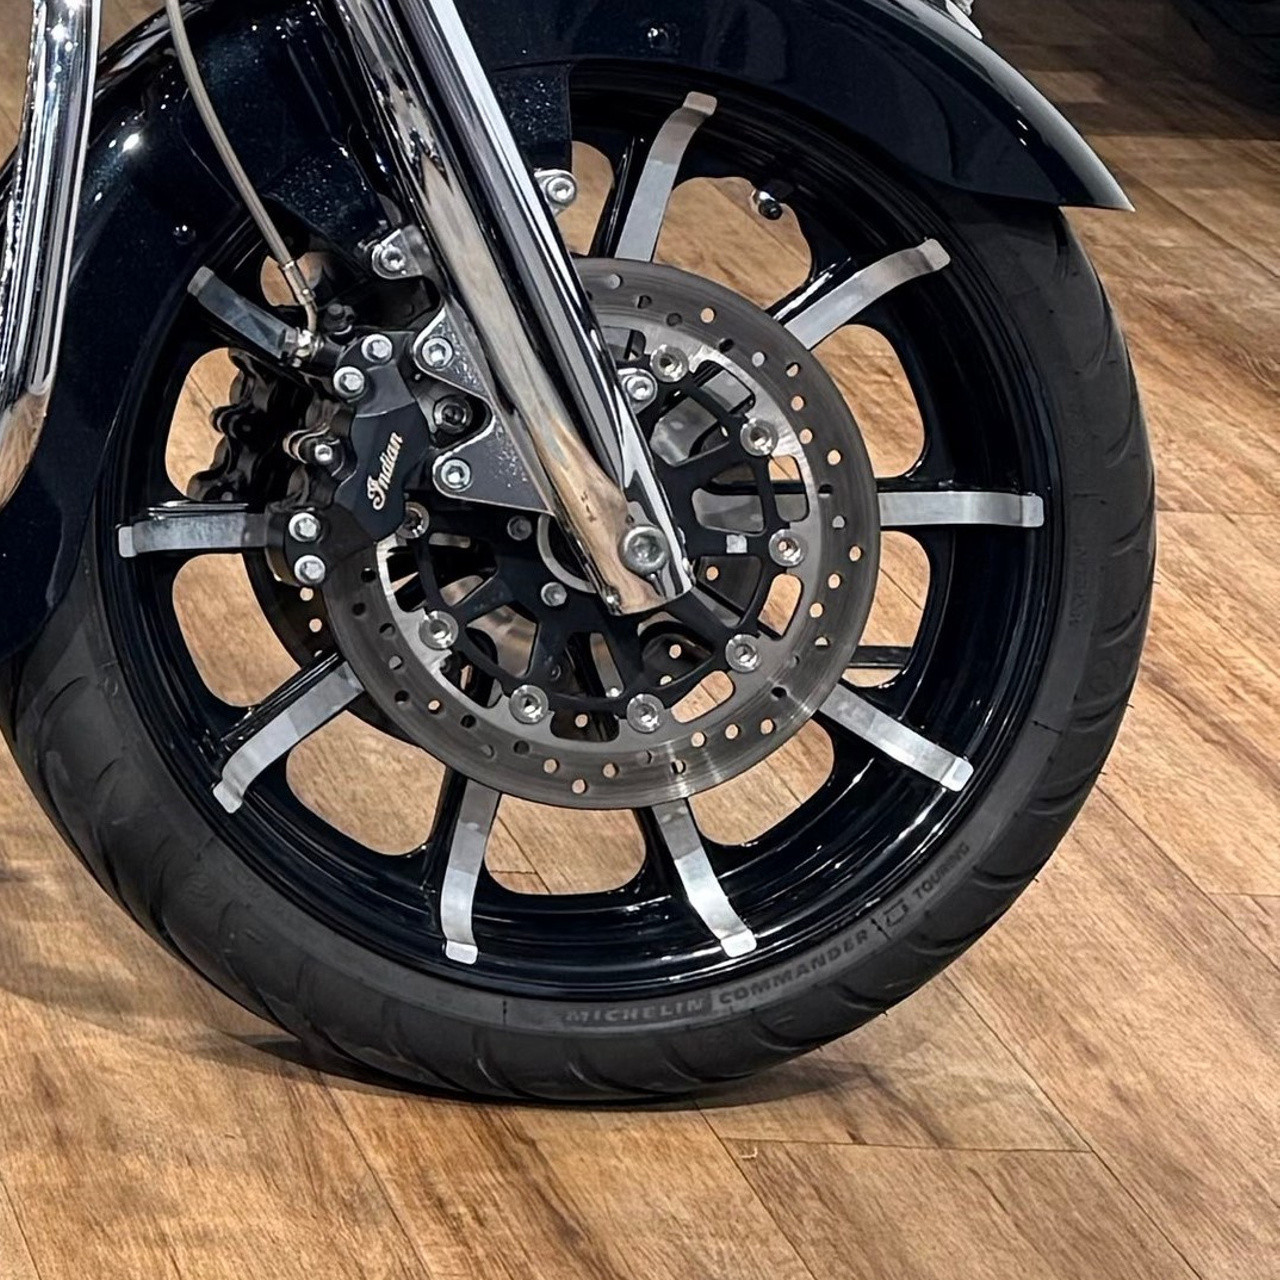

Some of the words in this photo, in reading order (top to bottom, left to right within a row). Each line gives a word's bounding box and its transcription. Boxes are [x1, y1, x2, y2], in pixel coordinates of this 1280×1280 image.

[367, 431, 403, 510] Indian
[565, 997, 704, 1022] MICHELIN
[718, 929, 869, 1005] COMMANDER
